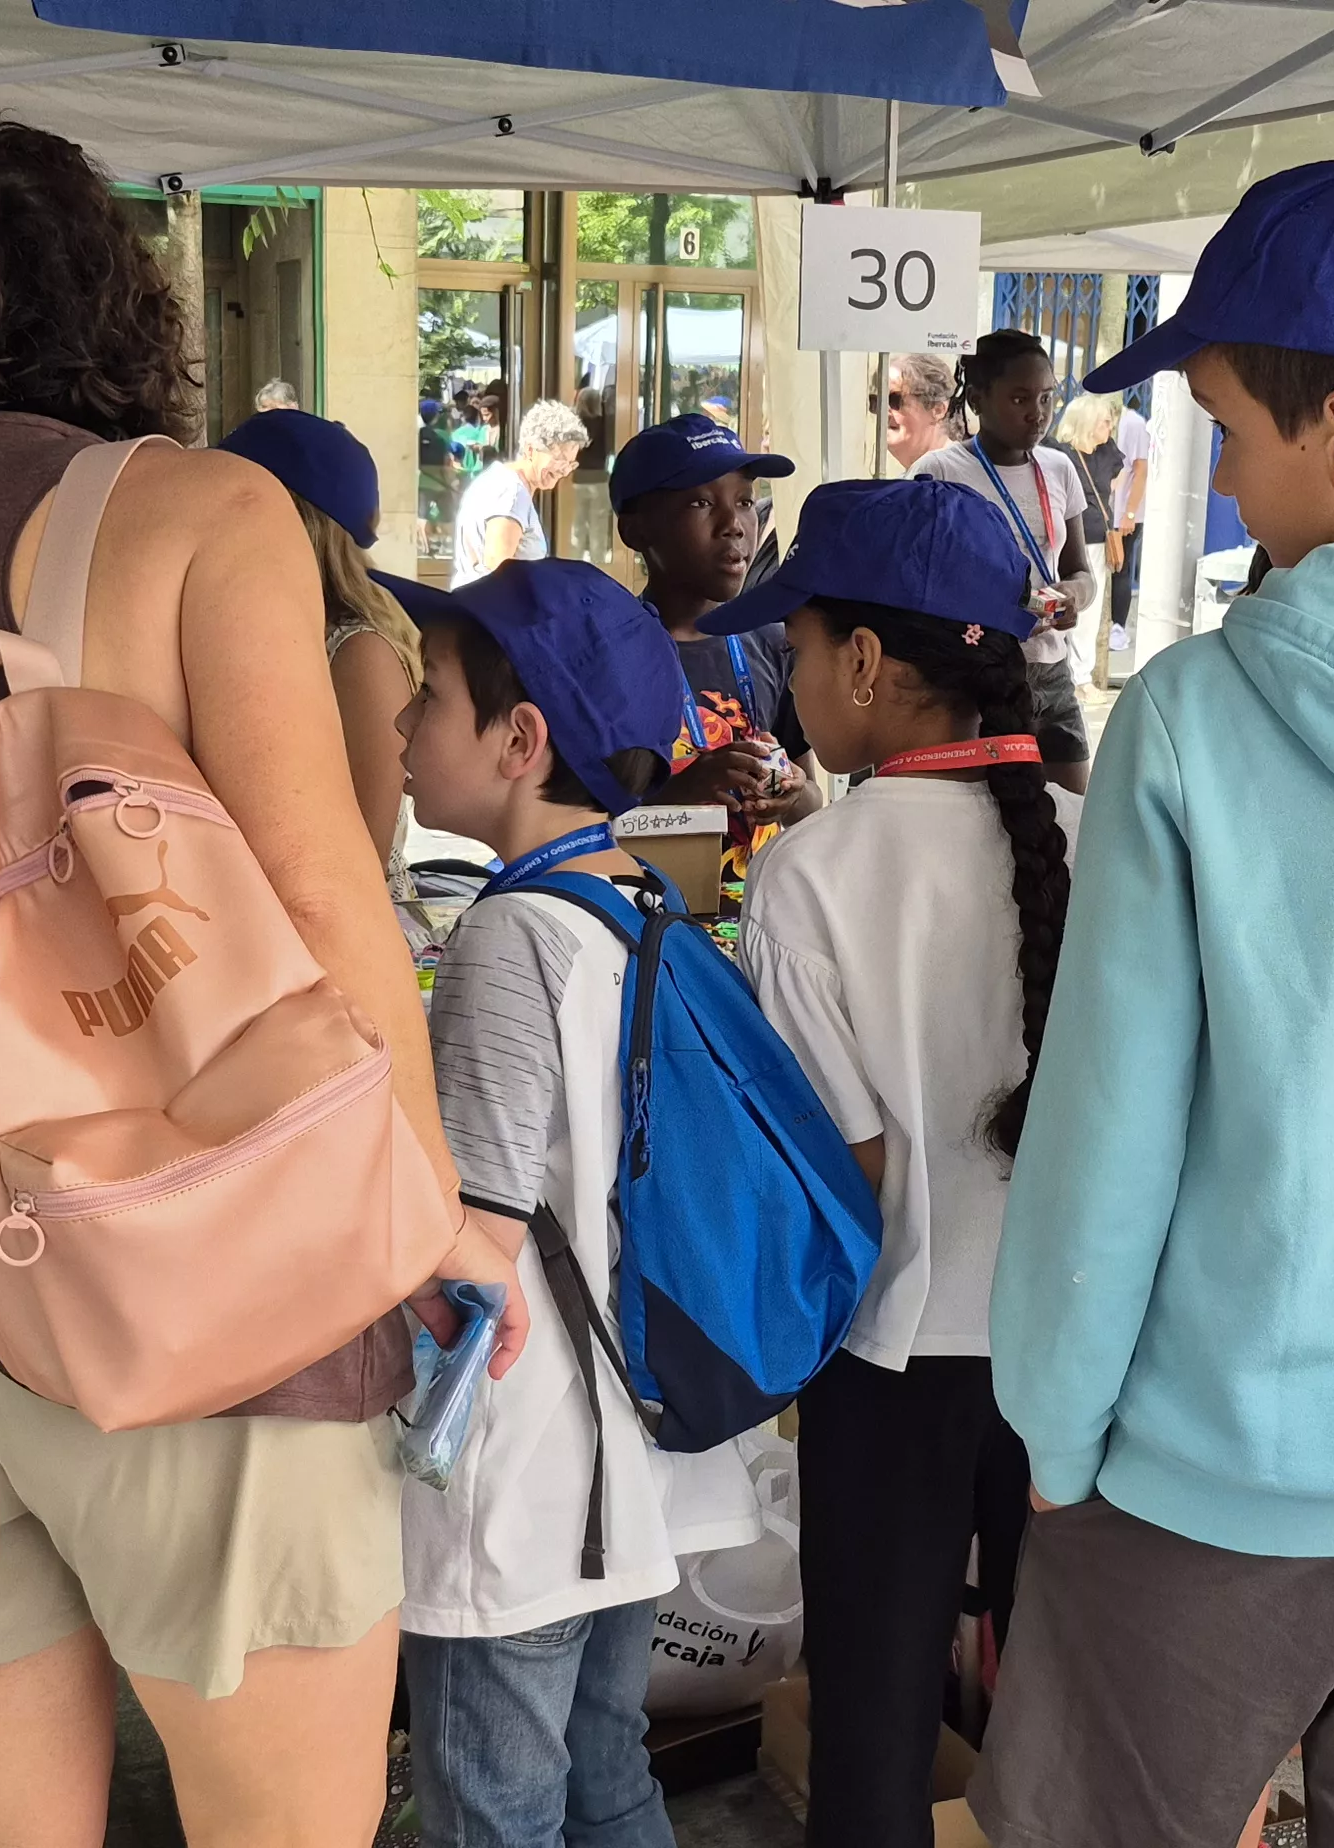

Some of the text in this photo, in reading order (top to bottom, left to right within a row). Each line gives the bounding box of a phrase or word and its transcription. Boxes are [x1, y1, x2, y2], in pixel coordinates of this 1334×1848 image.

[683, 231, 696, 256] 6
[848, 248, 936, 312] 30
[927, 340, 958, 349] Ibercaja
[914, 748, 977, 761] APRENDIENDO
[550, 833, 606, 856] APRENDIENDO
[61, 915, 198, 1037] PUMA
[655, 1610, 739, 1645] dación
